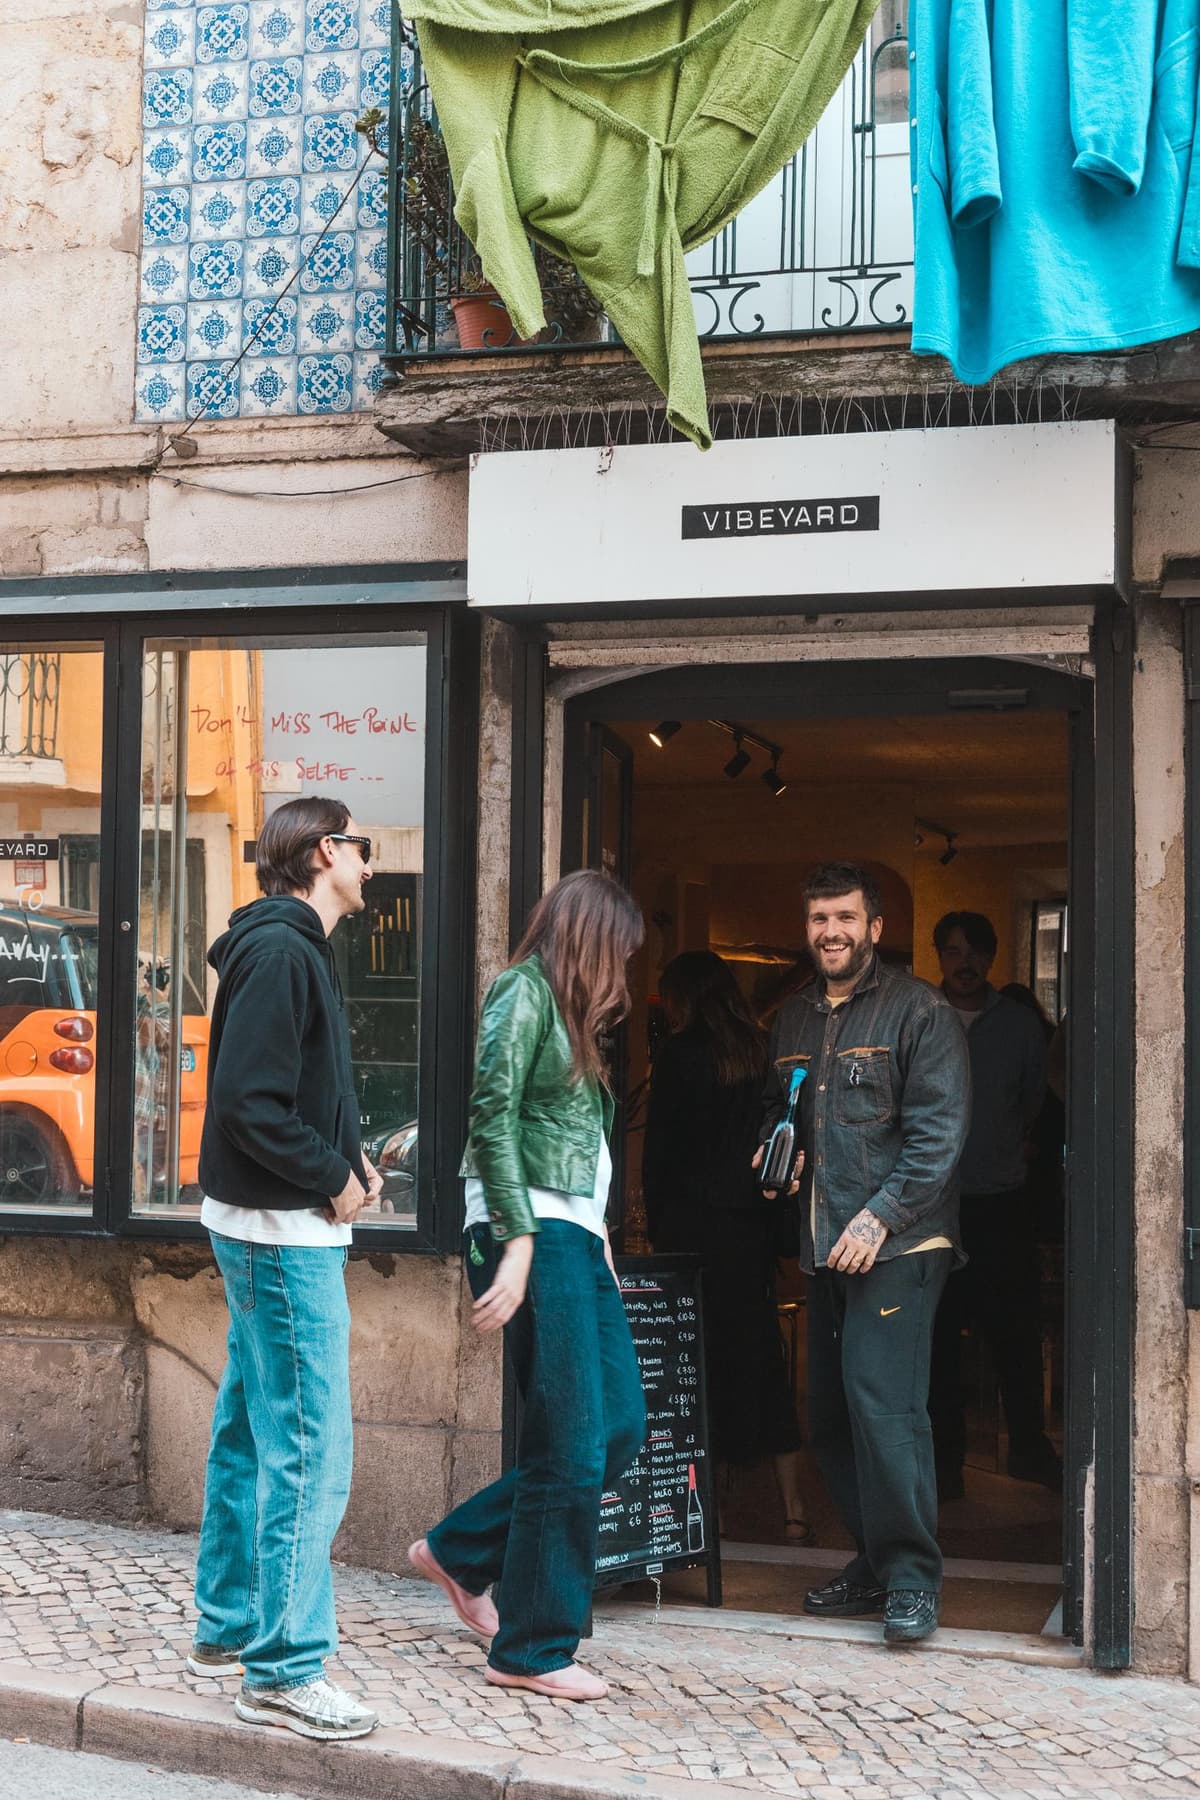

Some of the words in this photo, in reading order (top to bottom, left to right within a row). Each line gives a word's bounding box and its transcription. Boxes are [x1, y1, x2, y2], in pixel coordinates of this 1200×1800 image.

[702, 504, 859, 532] VIBEYARD
[191, 704, 257, 733] Don't
[320, 711, 361, 735] THE
[0, 843, 49, 856] EYARD
[629, 1502, 642, 1513] €10
[629, 1516, 641, 1527] €6
